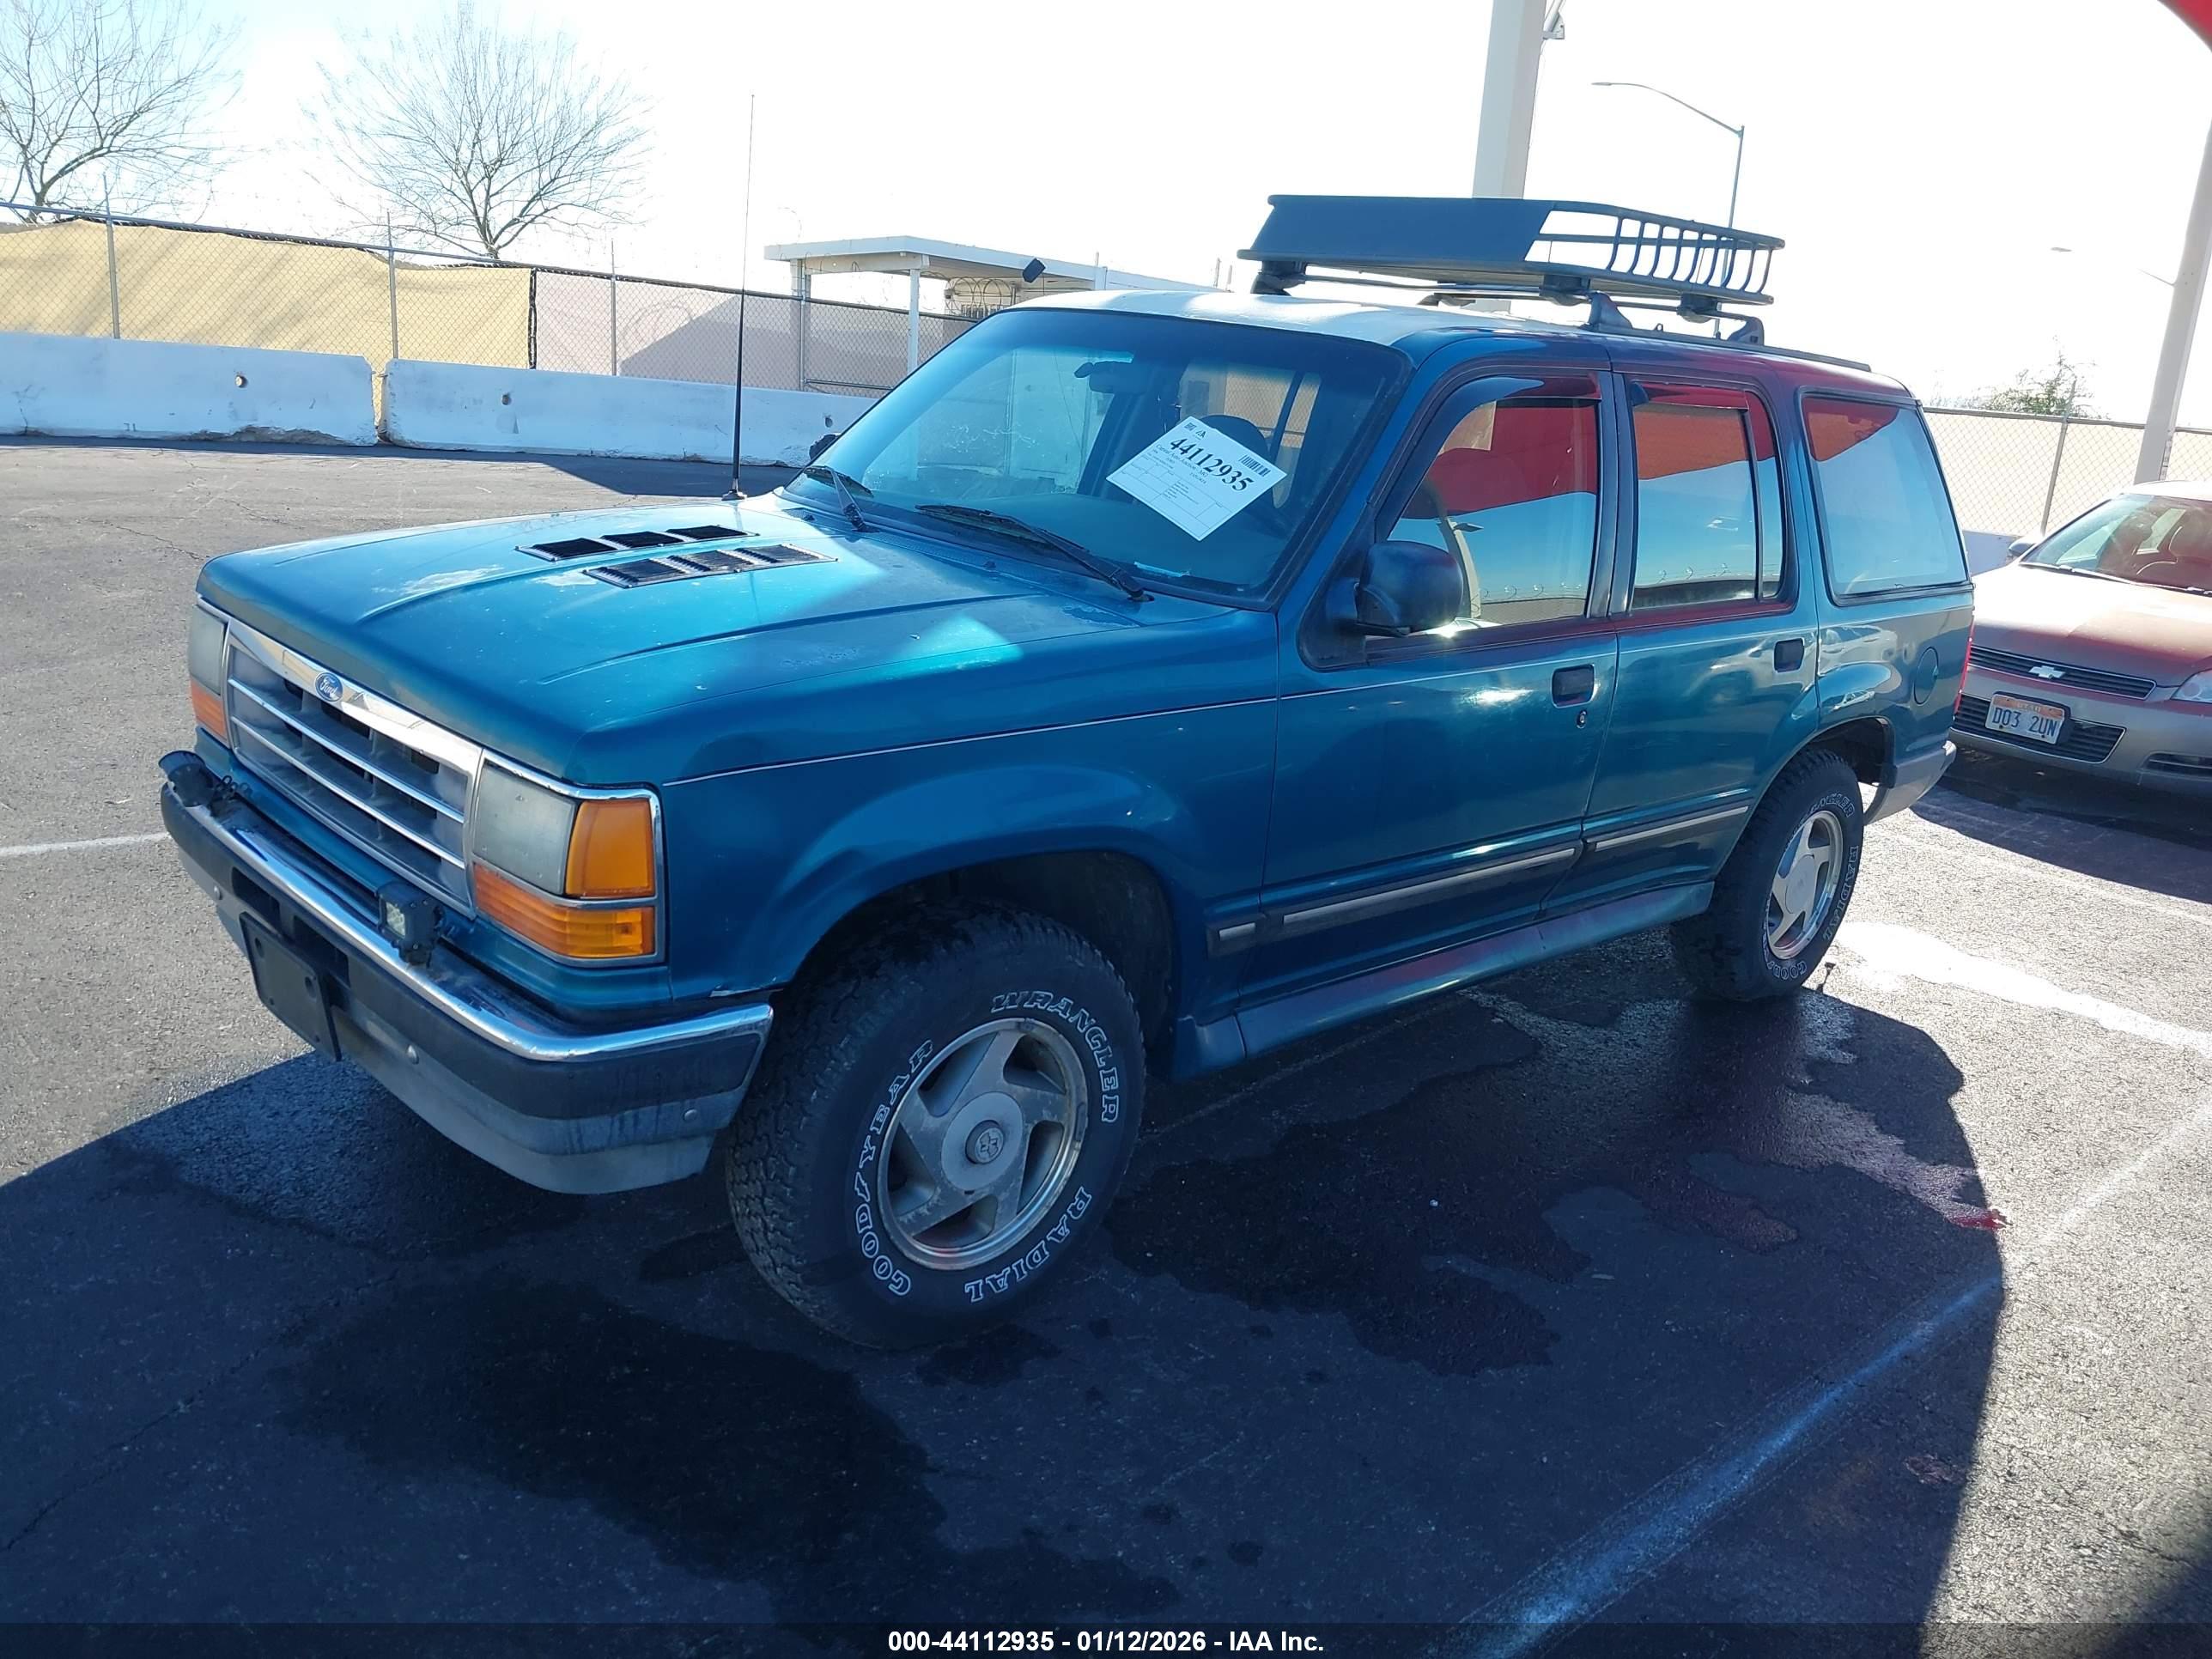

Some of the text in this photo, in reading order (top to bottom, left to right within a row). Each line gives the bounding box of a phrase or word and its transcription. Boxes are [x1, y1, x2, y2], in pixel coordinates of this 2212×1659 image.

[1170, 438, 1255, 492] 44112935
[2028, 715, 2057, 737] 2UN
[990, 990, 1120, 1123] WRANGLER
[854, 1039, 934, 1297] GOODYEAR
[964, 1187, 1093, 1303] RADIAL
